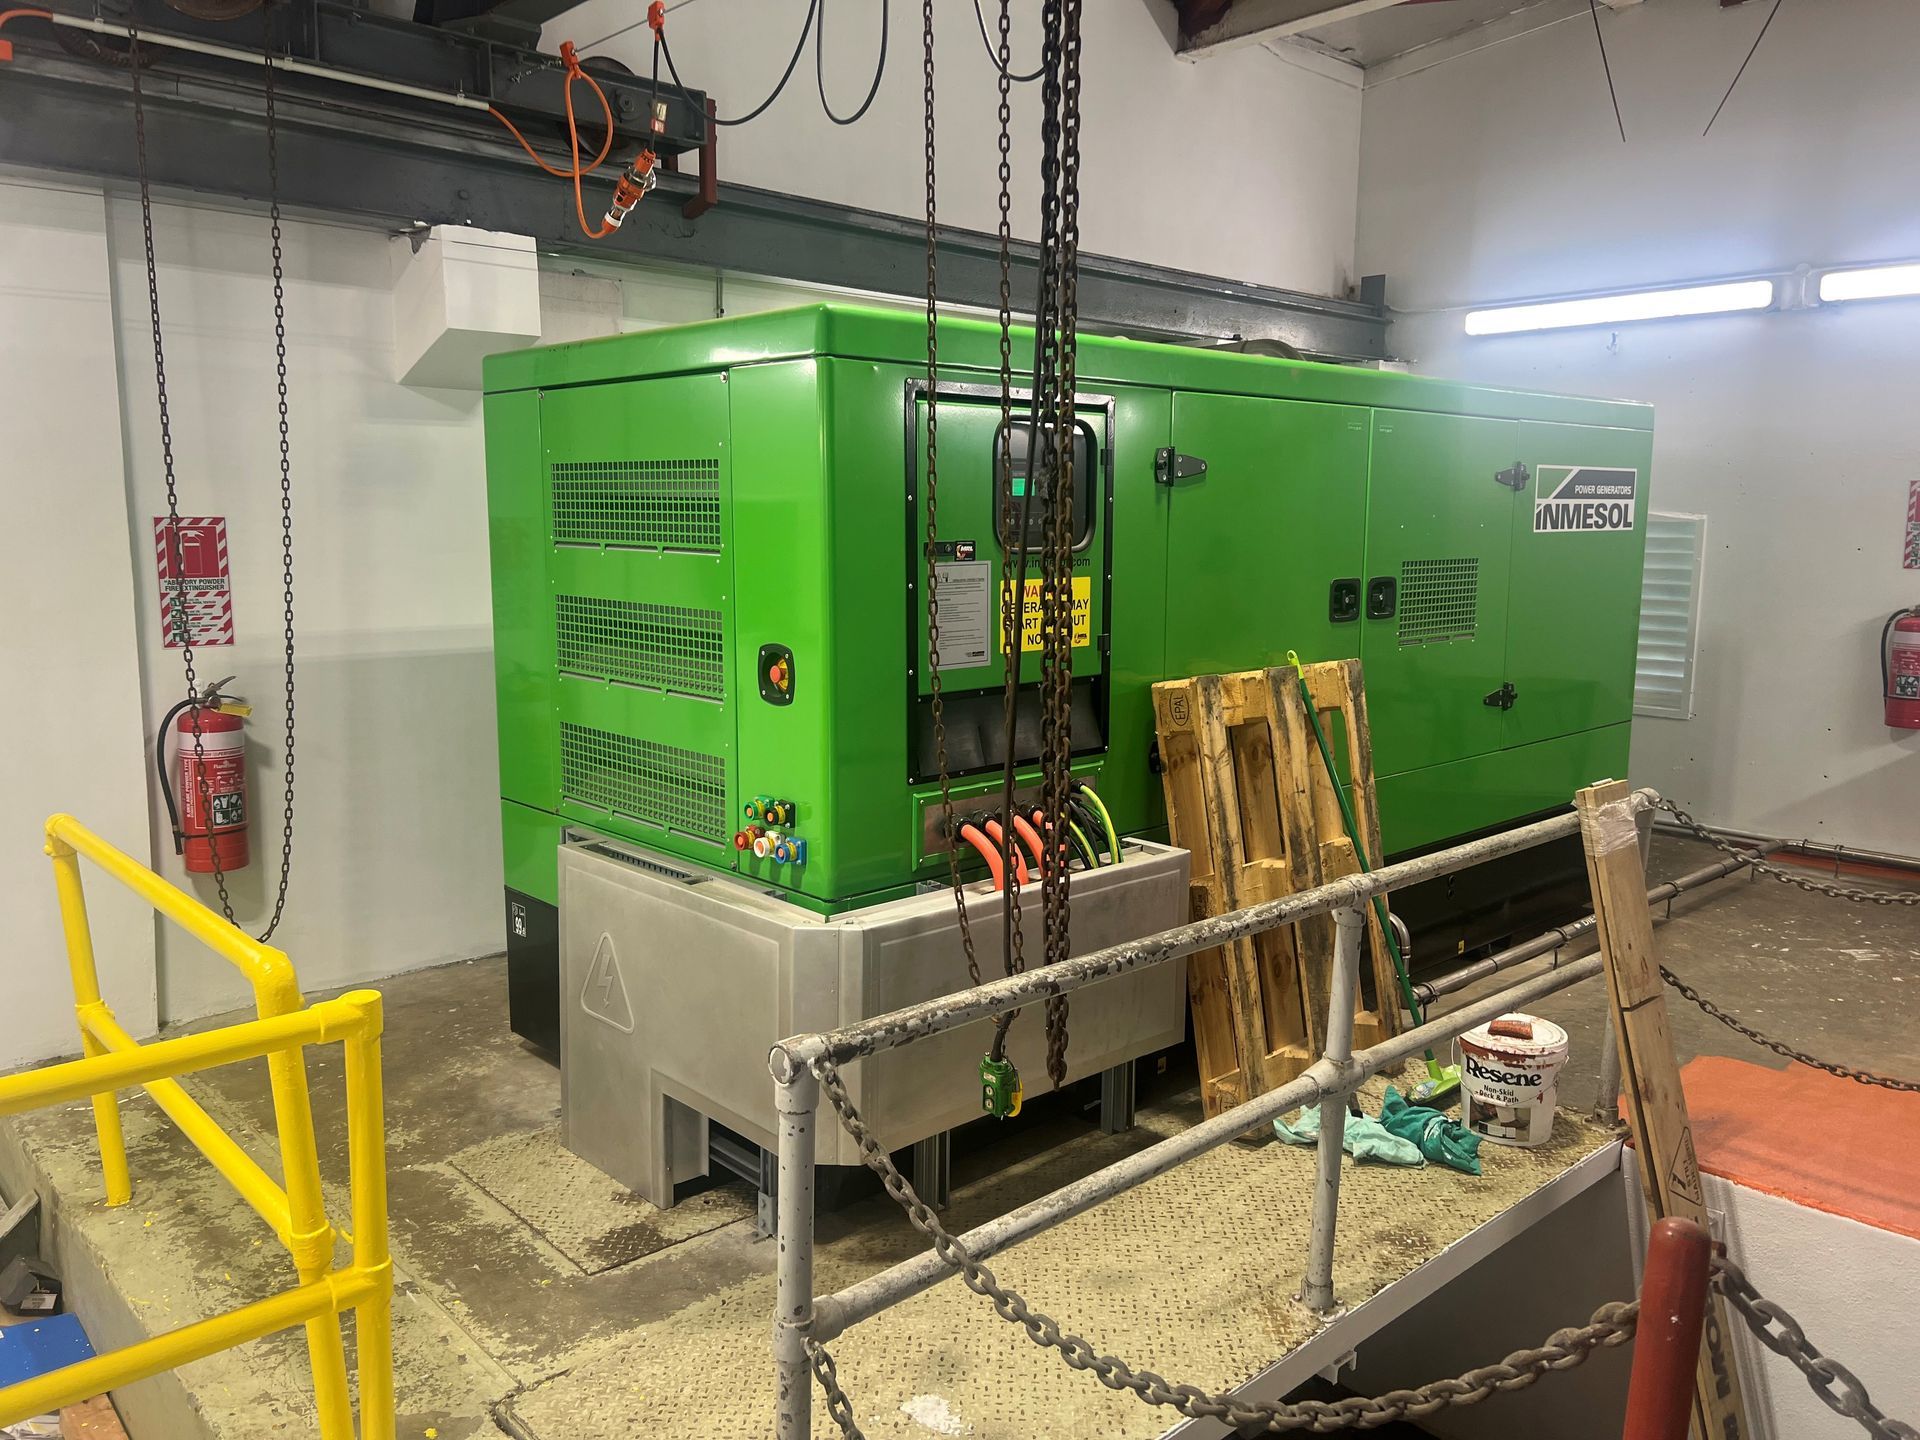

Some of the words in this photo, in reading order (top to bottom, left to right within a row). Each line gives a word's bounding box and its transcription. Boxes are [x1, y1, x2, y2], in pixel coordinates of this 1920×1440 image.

[1575, 485, 1595, 494] POWER
[1597, 485, 1632, 495] GENERATORS
[1535, 503, 1632, 530] INMESOL
[1173, 694, 1186, 720] EPAL
[1465, 1054, 1542, 1087] Resene
[1480, 1090, 1494, 1099] Deck
[1503, 1096, 1519, 1104] Path
[1483, 1084, 1514, 1096] Non-Skid
